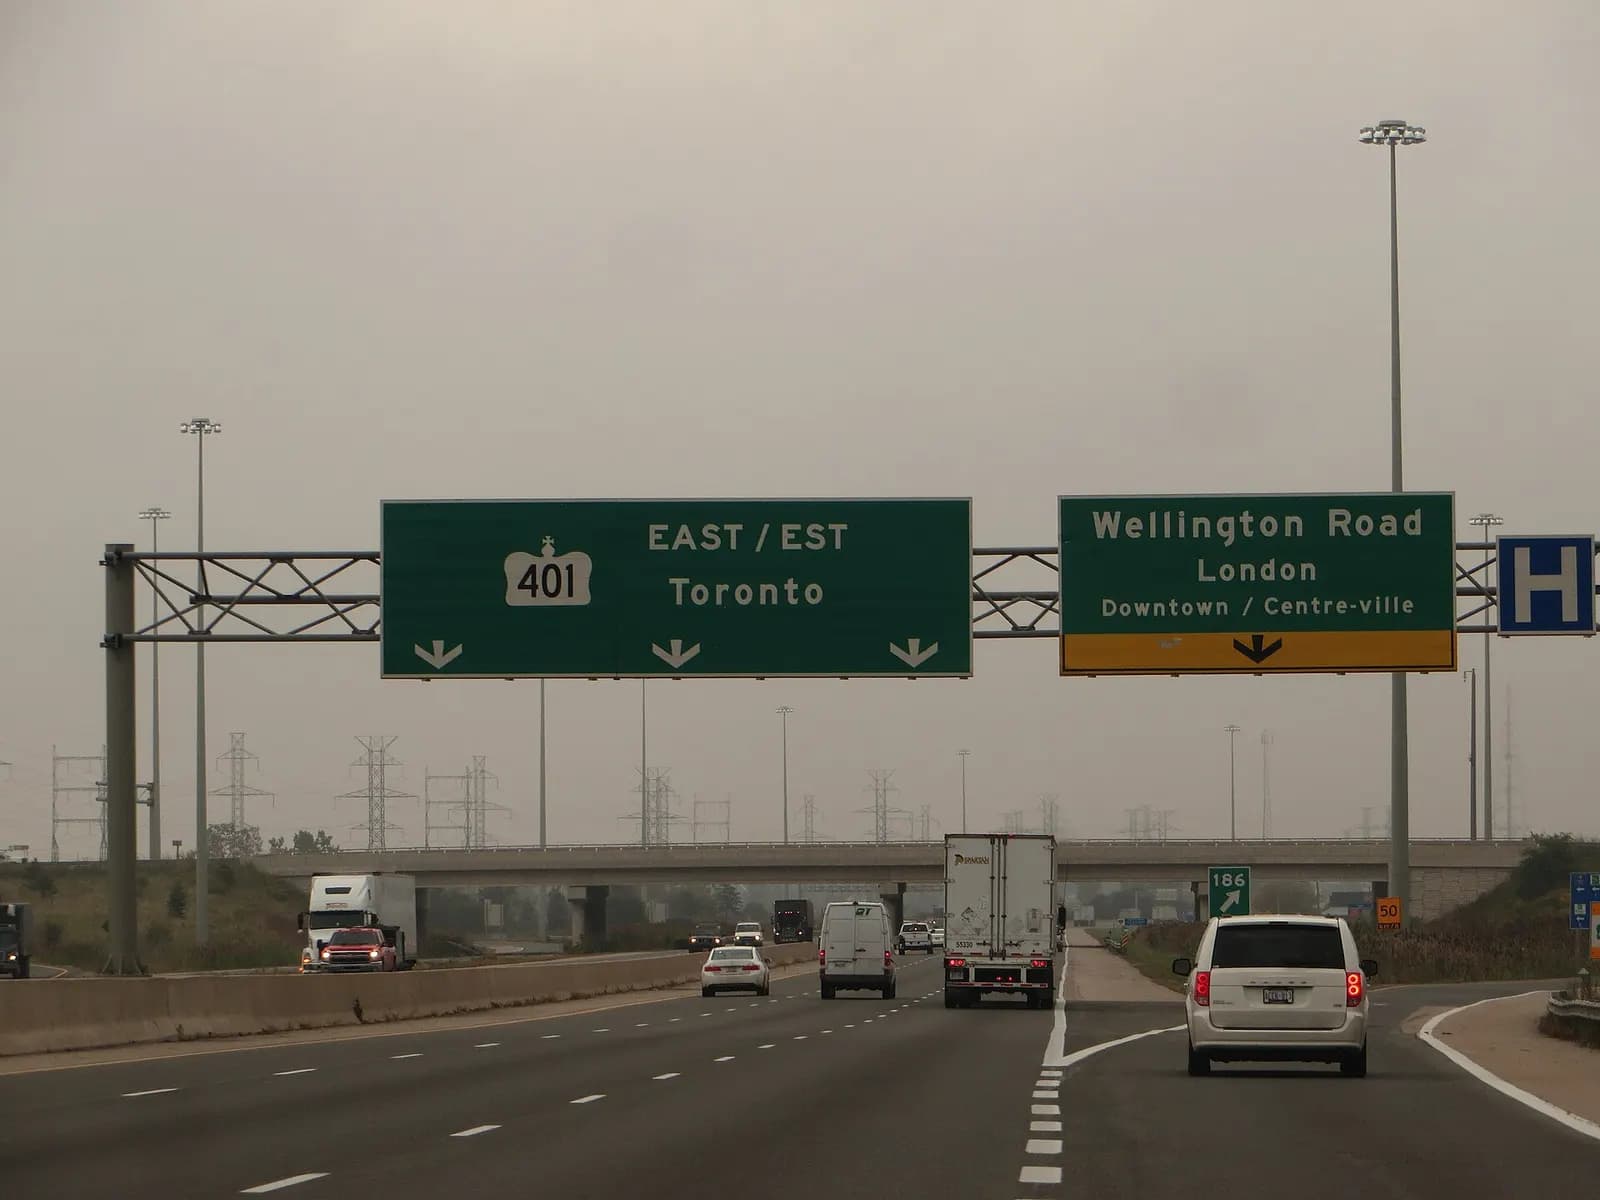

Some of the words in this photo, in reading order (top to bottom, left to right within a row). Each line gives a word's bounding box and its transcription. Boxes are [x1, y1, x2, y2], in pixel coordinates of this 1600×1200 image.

[648, 523, 744, 551] EAST
[755, 523, 770, 553] /
[781, 523, 848, 550] EST
[1093, 509, 1304, 548] Wellington
[1328, 508, 1422, 537] Road
[517, 563, 575, 599] 401
[1198, 558, 1317, 582] London
[1514, 546, 1579, 623] H
[668, 577, 823, 606] Toronto
[1102, 598, 1228, 617] Downtown
[1242, 596, 1254, 617] /
[1264, 596, 1415, 616] Centre-ville
[1213, 873, 1245, 887] 186
[1380, 904, 1398, 917] 50
